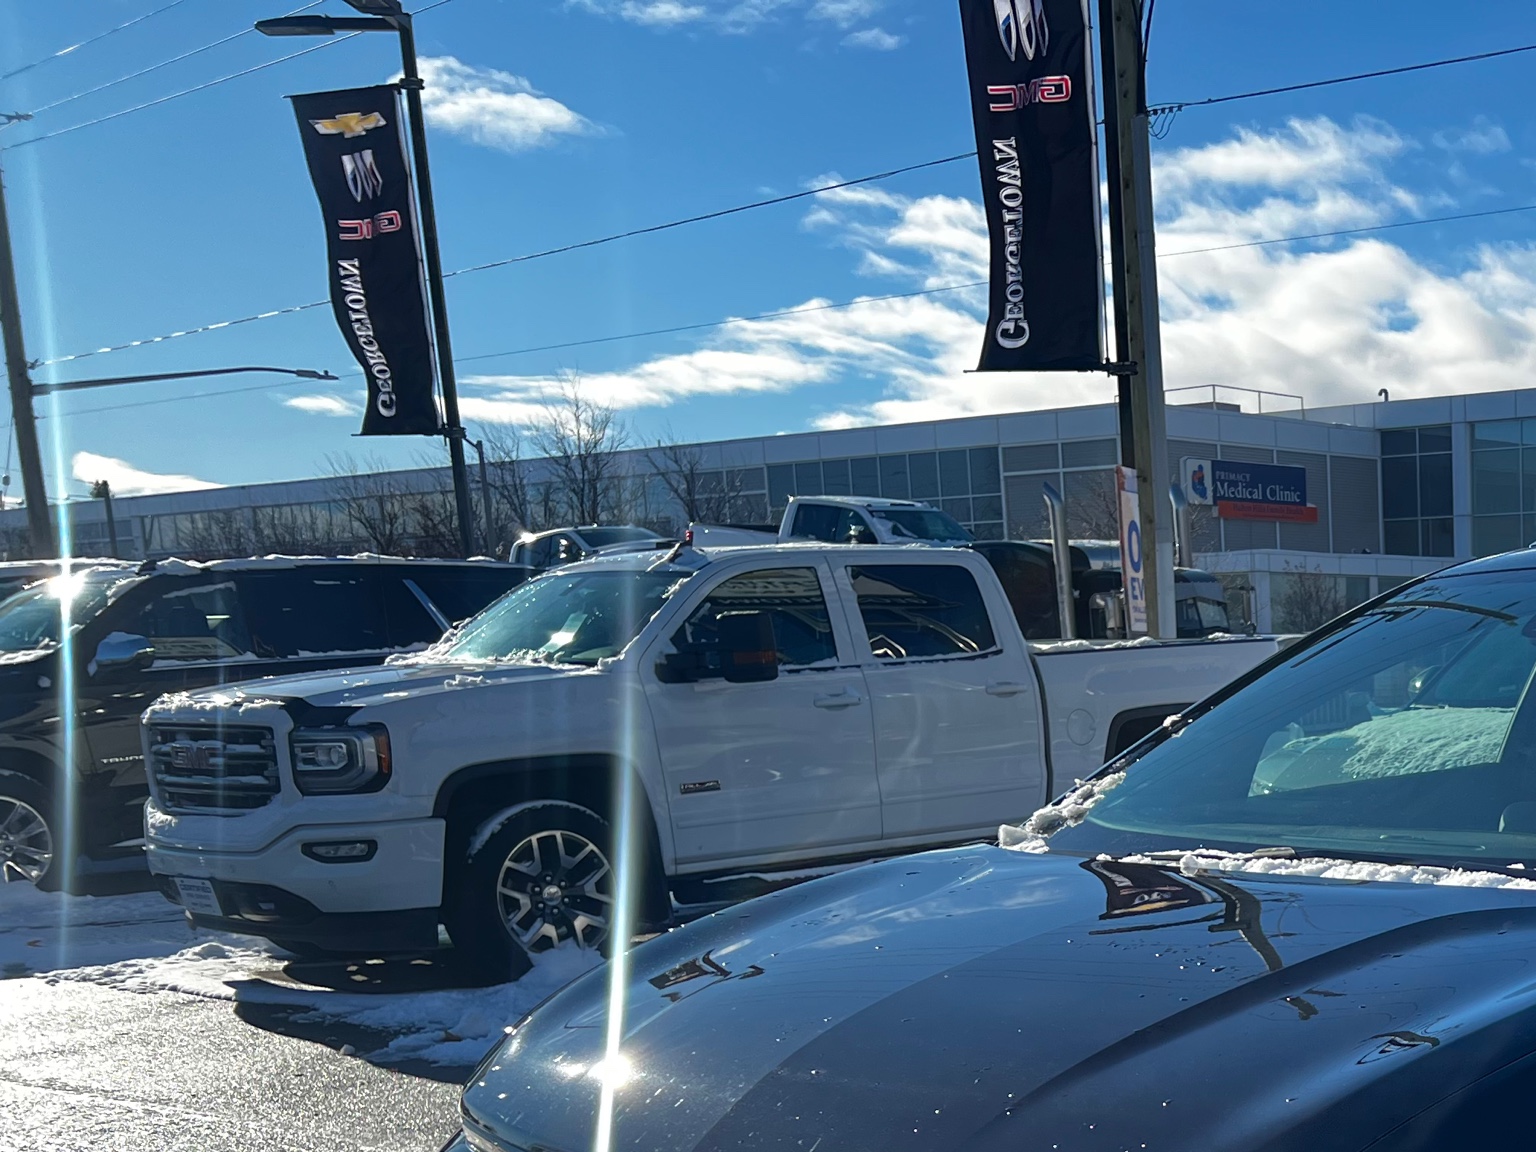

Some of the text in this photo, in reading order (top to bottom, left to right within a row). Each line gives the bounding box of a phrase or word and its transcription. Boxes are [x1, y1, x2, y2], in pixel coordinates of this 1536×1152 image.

[1215, 470, 1251, 482] PRIMACY
[1216, 481, 1301, 502] Medical Clinic
